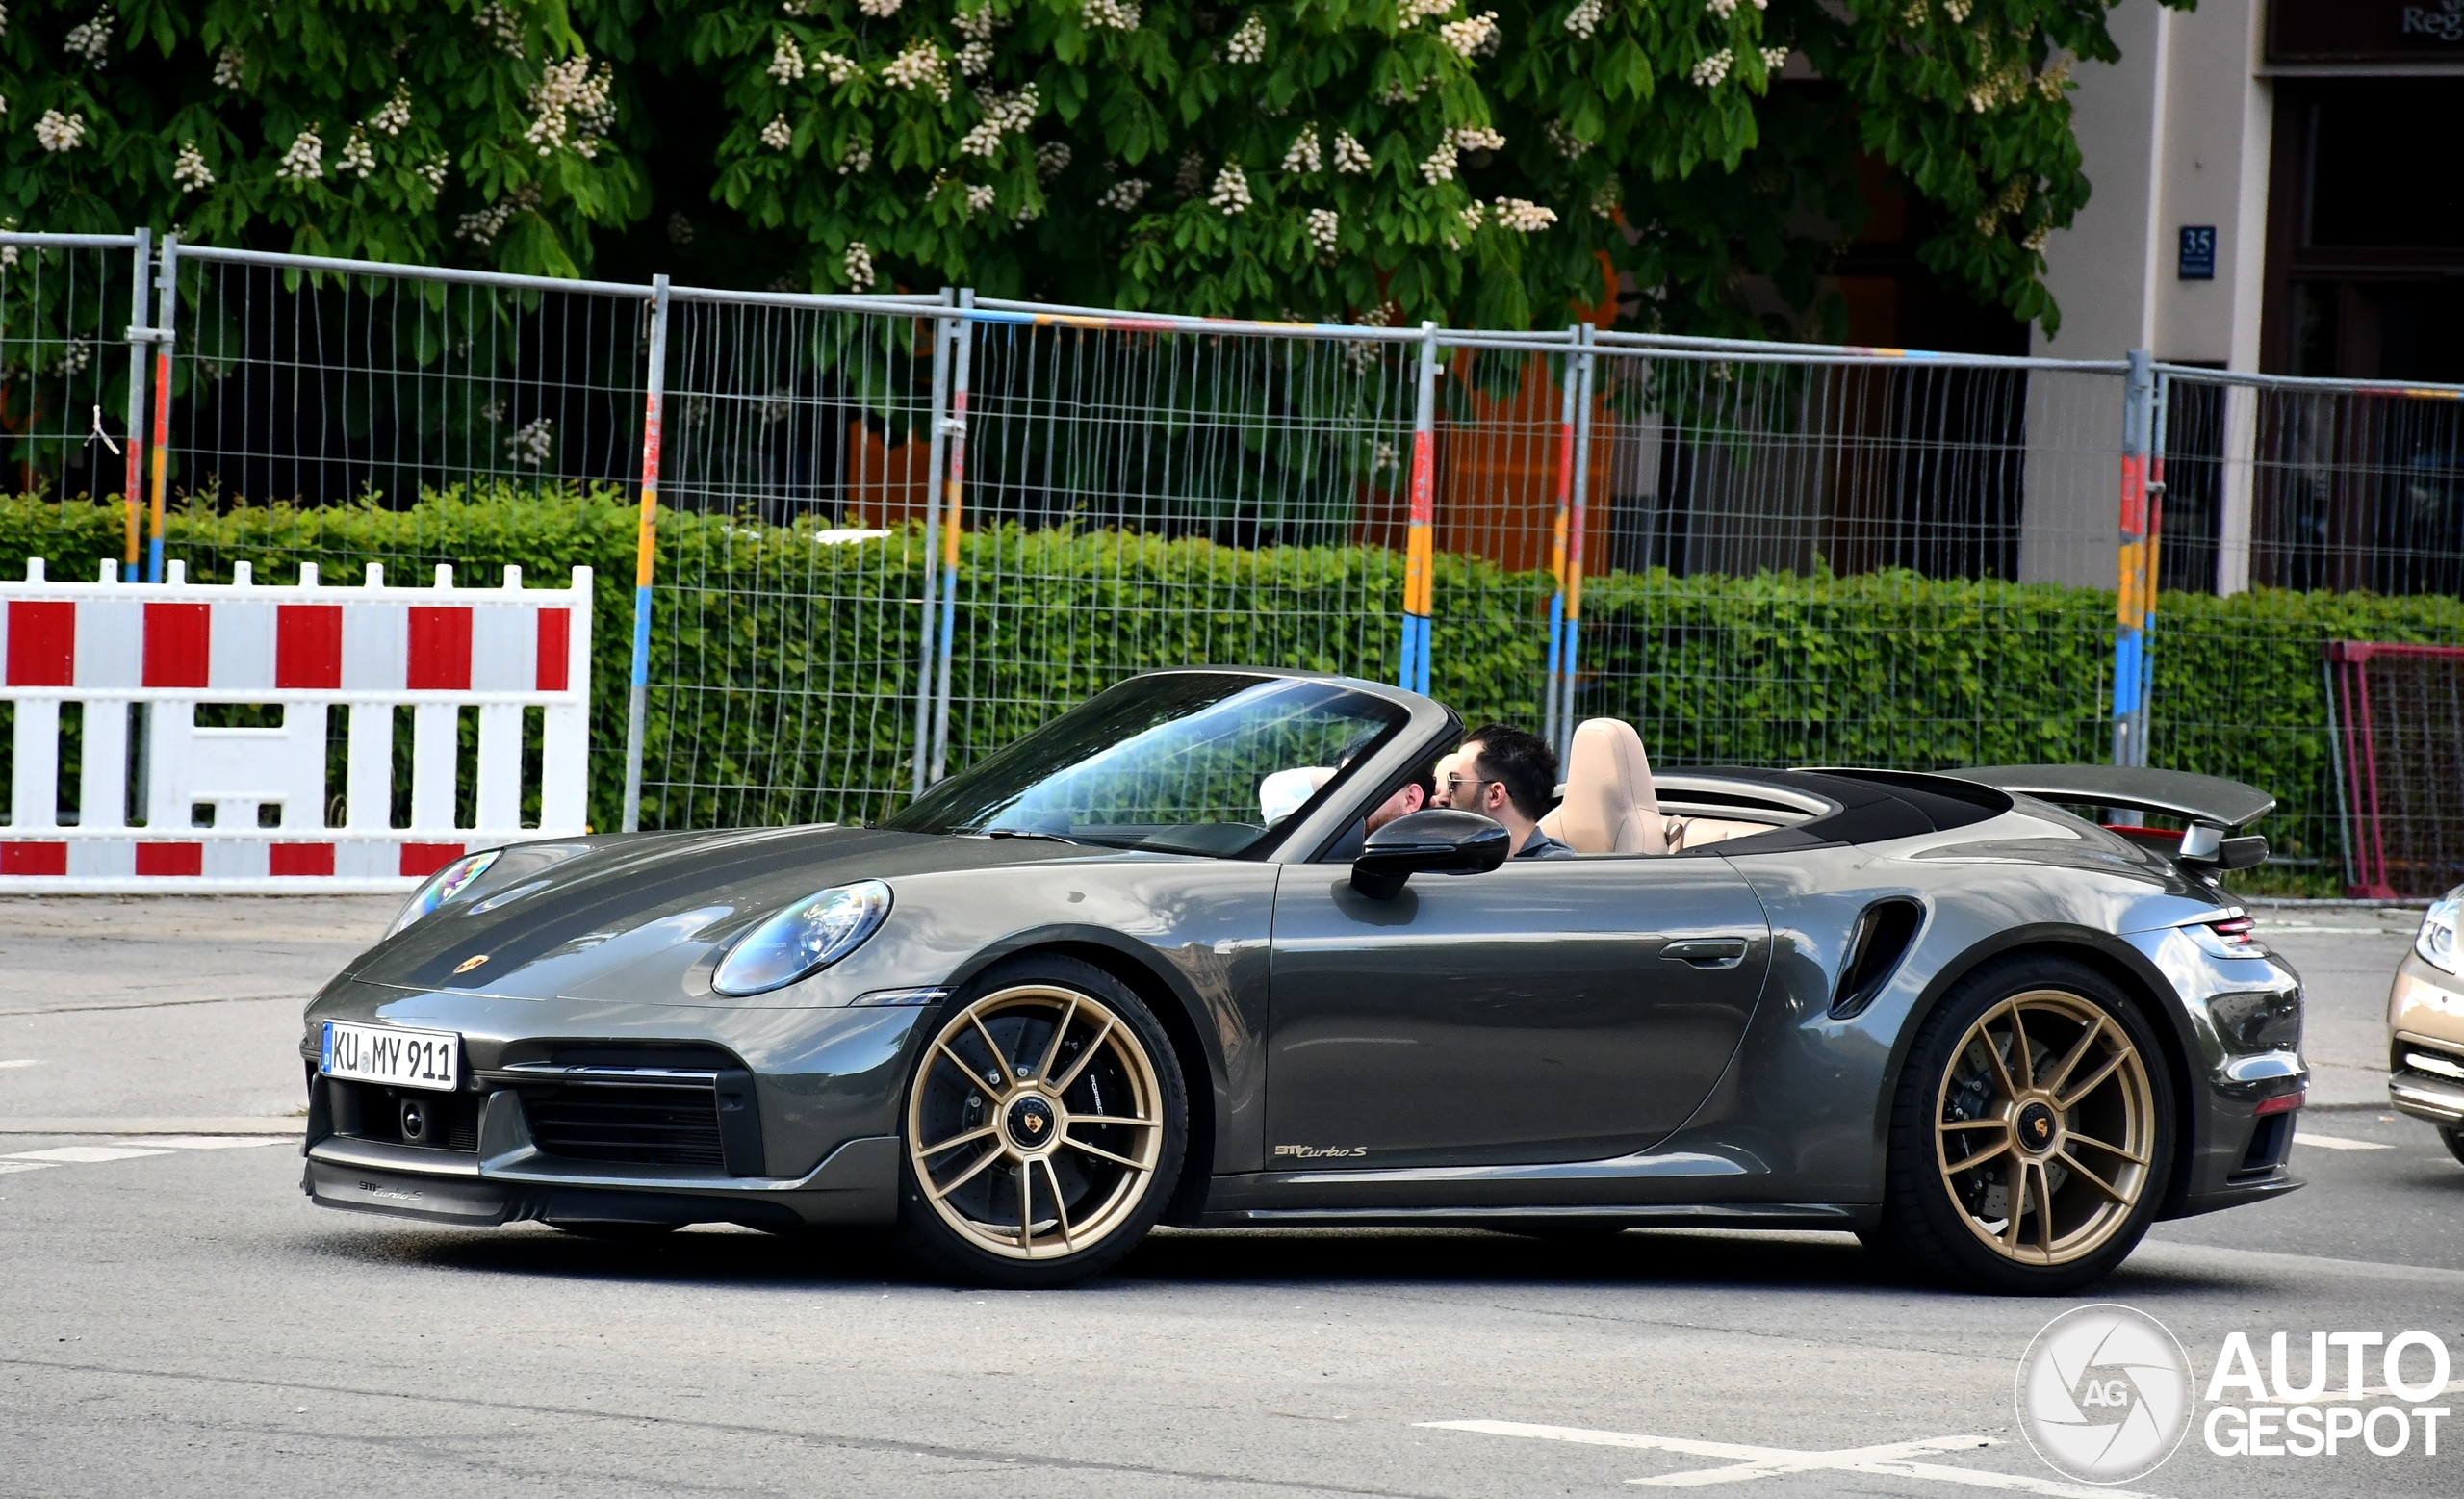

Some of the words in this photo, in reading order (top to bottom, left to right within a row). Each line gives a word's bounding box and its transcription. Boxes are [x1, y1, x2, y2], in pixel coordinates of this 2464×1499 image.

[2183, 229, 2211, 255] 35
[324, 1053, 329, 1065] D
[333, 1030, 358, 1071] KU
[372, 1035, 401, 1075] MY
[407, 1040, 451, 1081] 911
[1348, 1146, 1368, 1157] S
